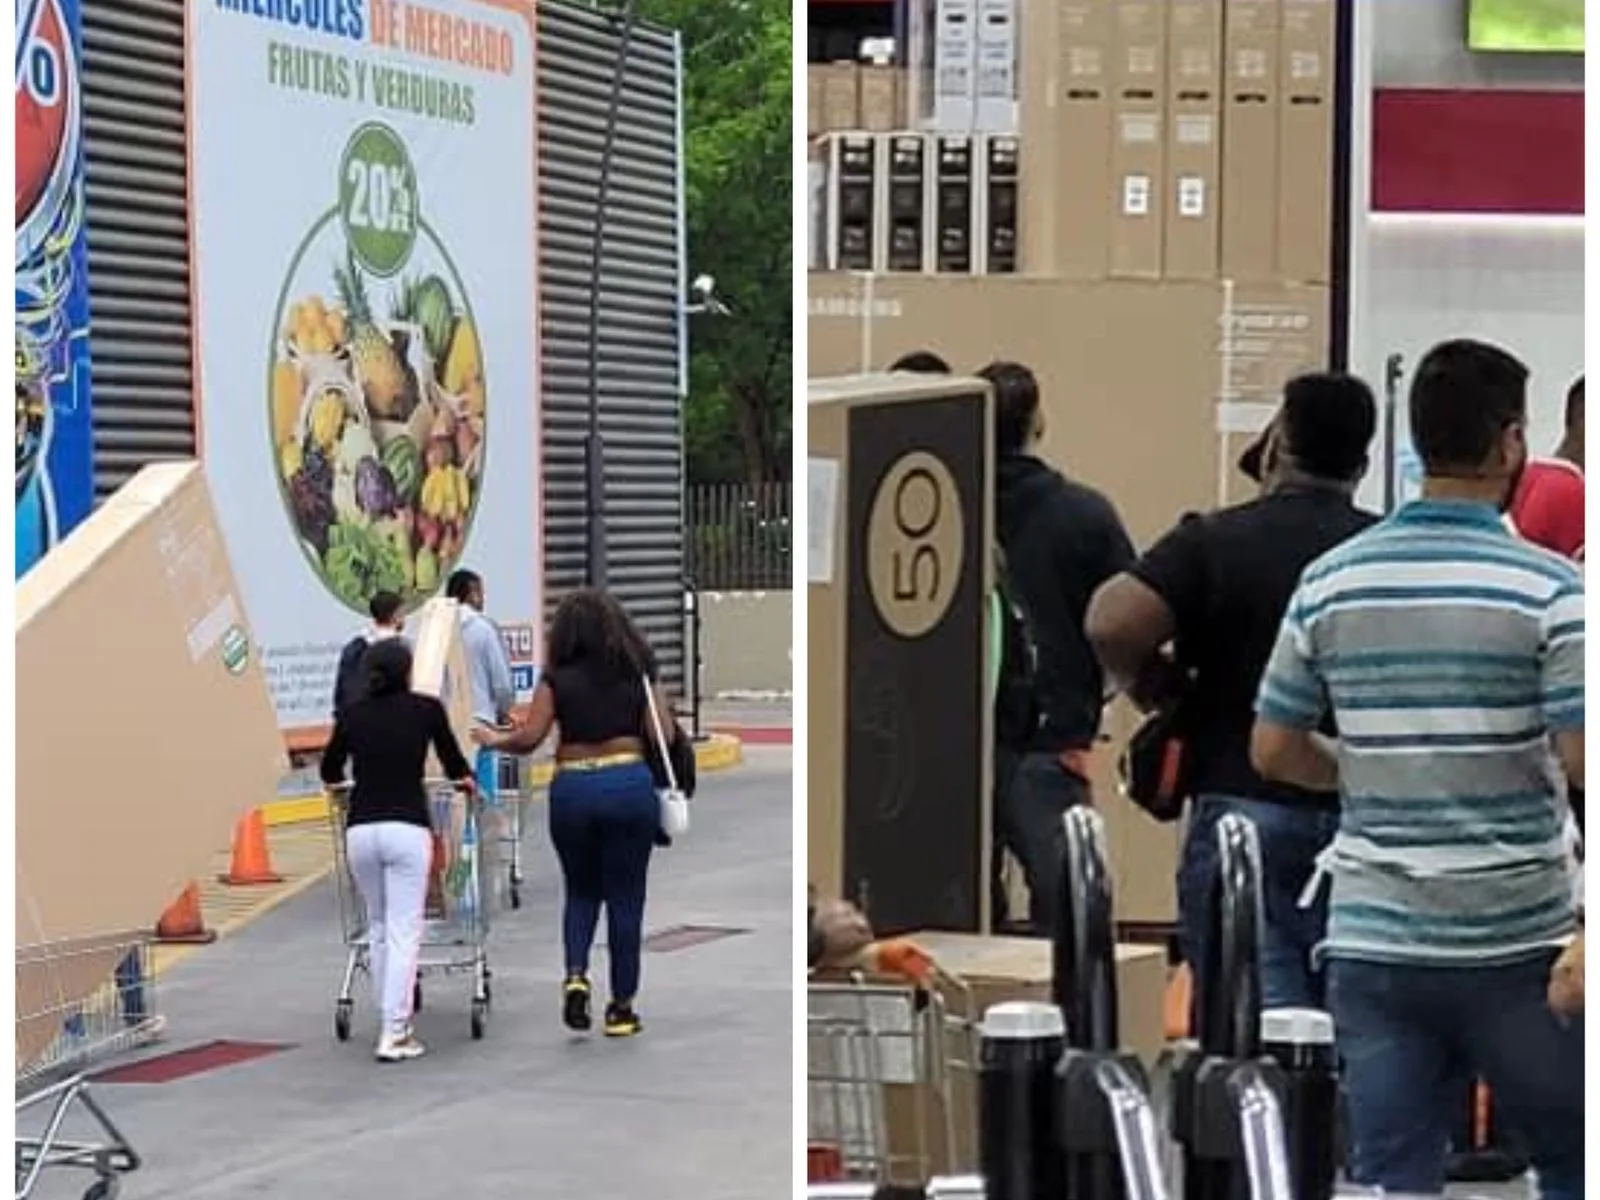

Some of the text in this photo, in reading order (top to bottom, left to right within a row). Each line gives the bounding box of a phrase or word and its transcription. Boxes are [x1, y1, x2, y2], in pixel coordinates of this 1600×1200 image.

[370, 0, 401, 48] DE
[404, 4, 513, 76] MERCADO
[267, 41, 475, 124] FRUTAS Y VERDURAS
[894, 467, 941, 600] 50
